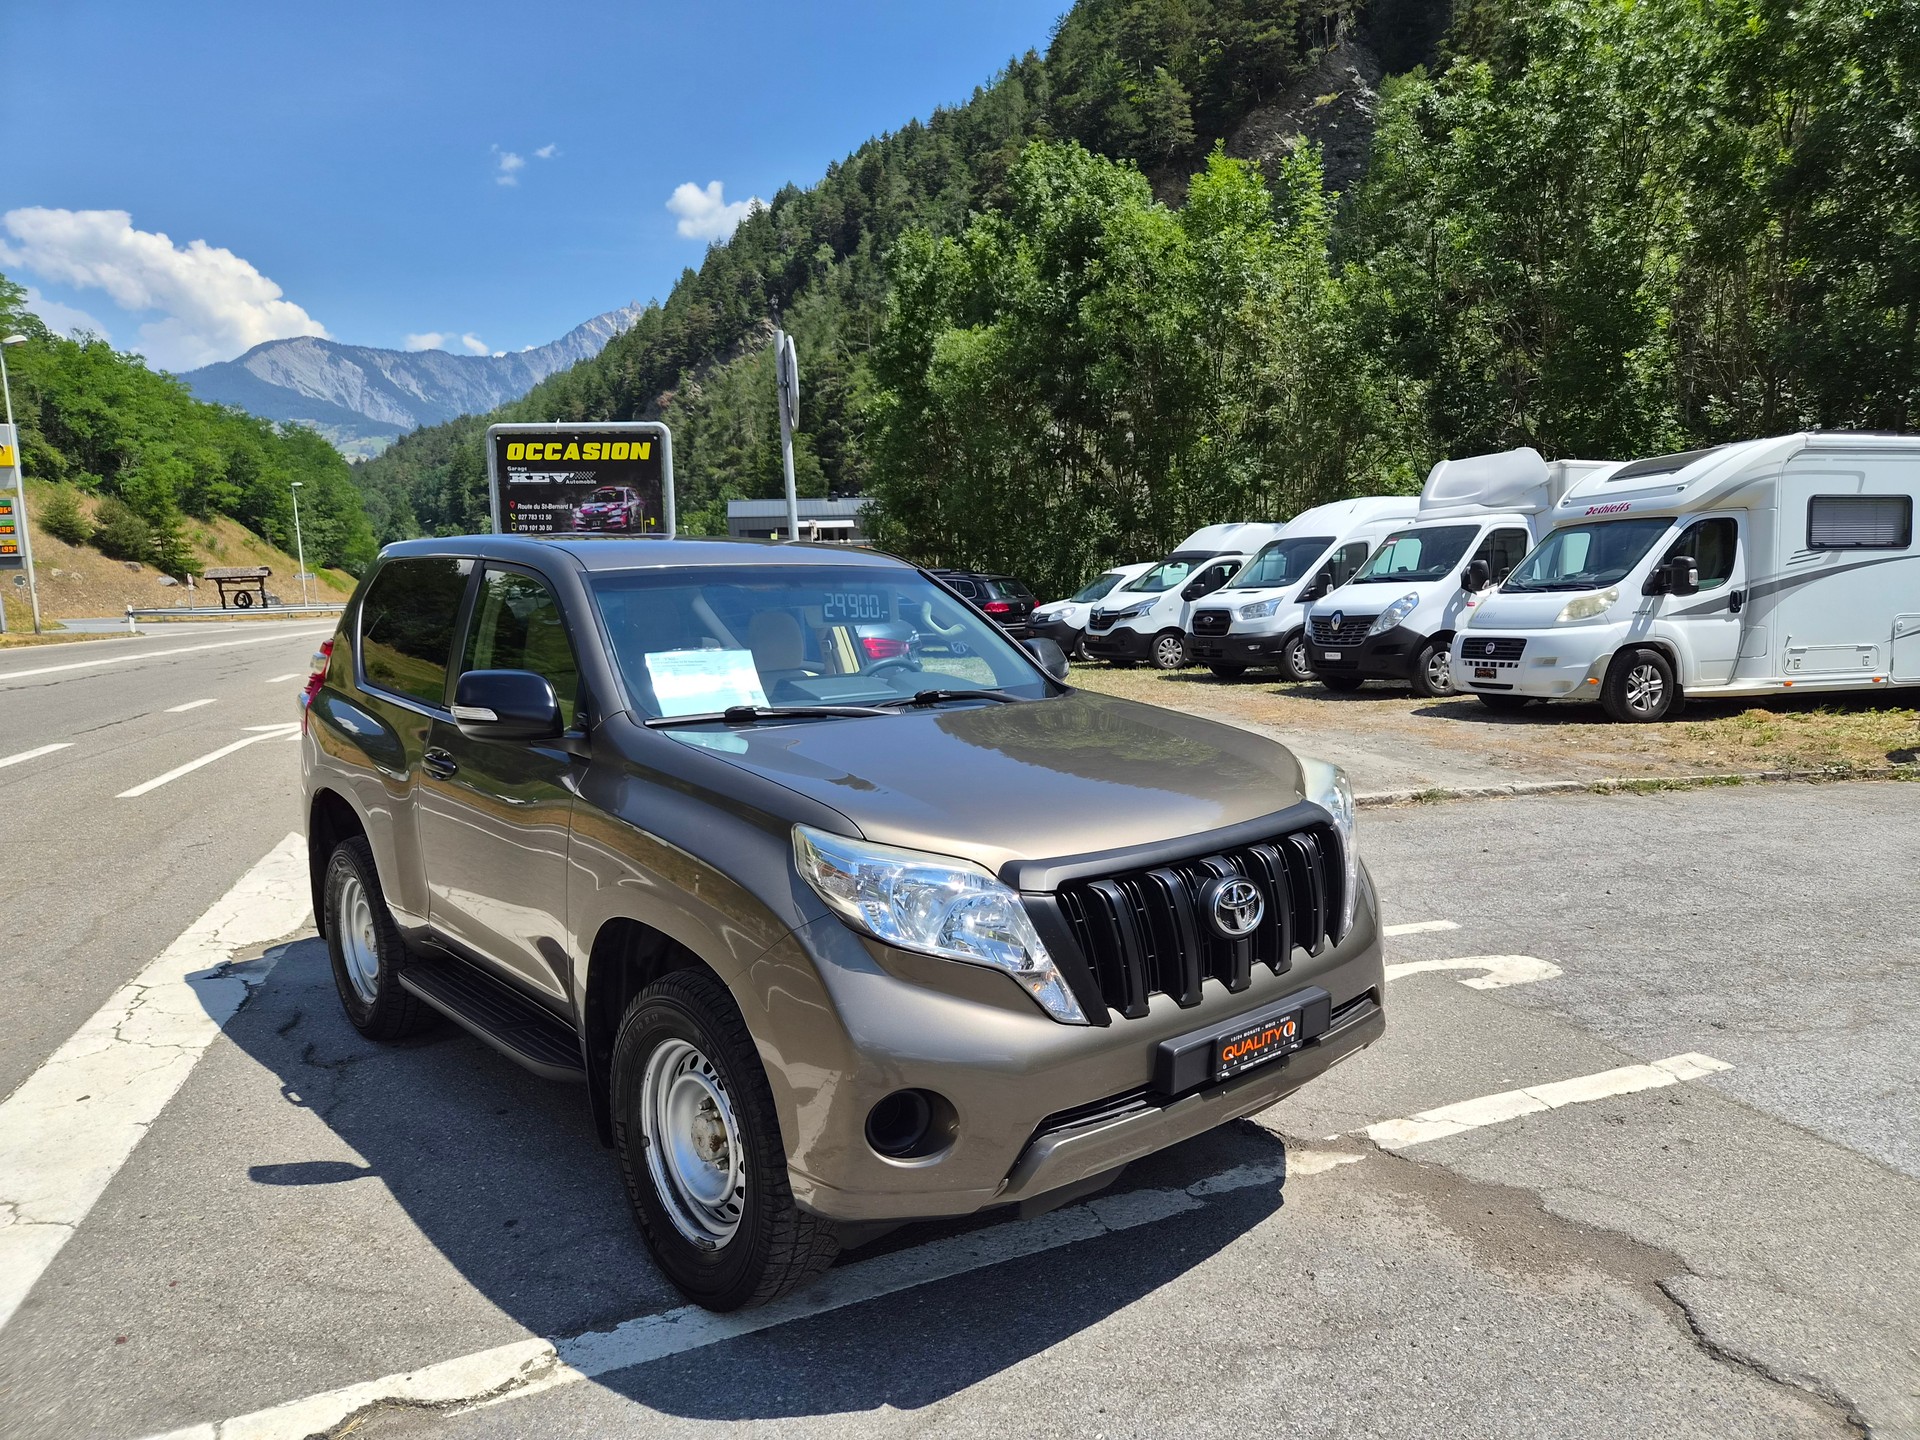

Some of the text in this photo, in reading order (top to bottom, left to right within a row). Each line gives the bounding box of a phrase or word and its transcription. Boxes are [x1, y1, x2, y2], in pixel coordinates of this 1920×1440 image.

[506, 442, 651, 460] OCCASION
[1584, 502, 1632, 516] Dethleffs
[1222, 1026, 1283, 1061] QUALITY
[1222, 1036, 1295, 1070] GARANTIE
[614, 1121, 650, 1227] MICHELIN
